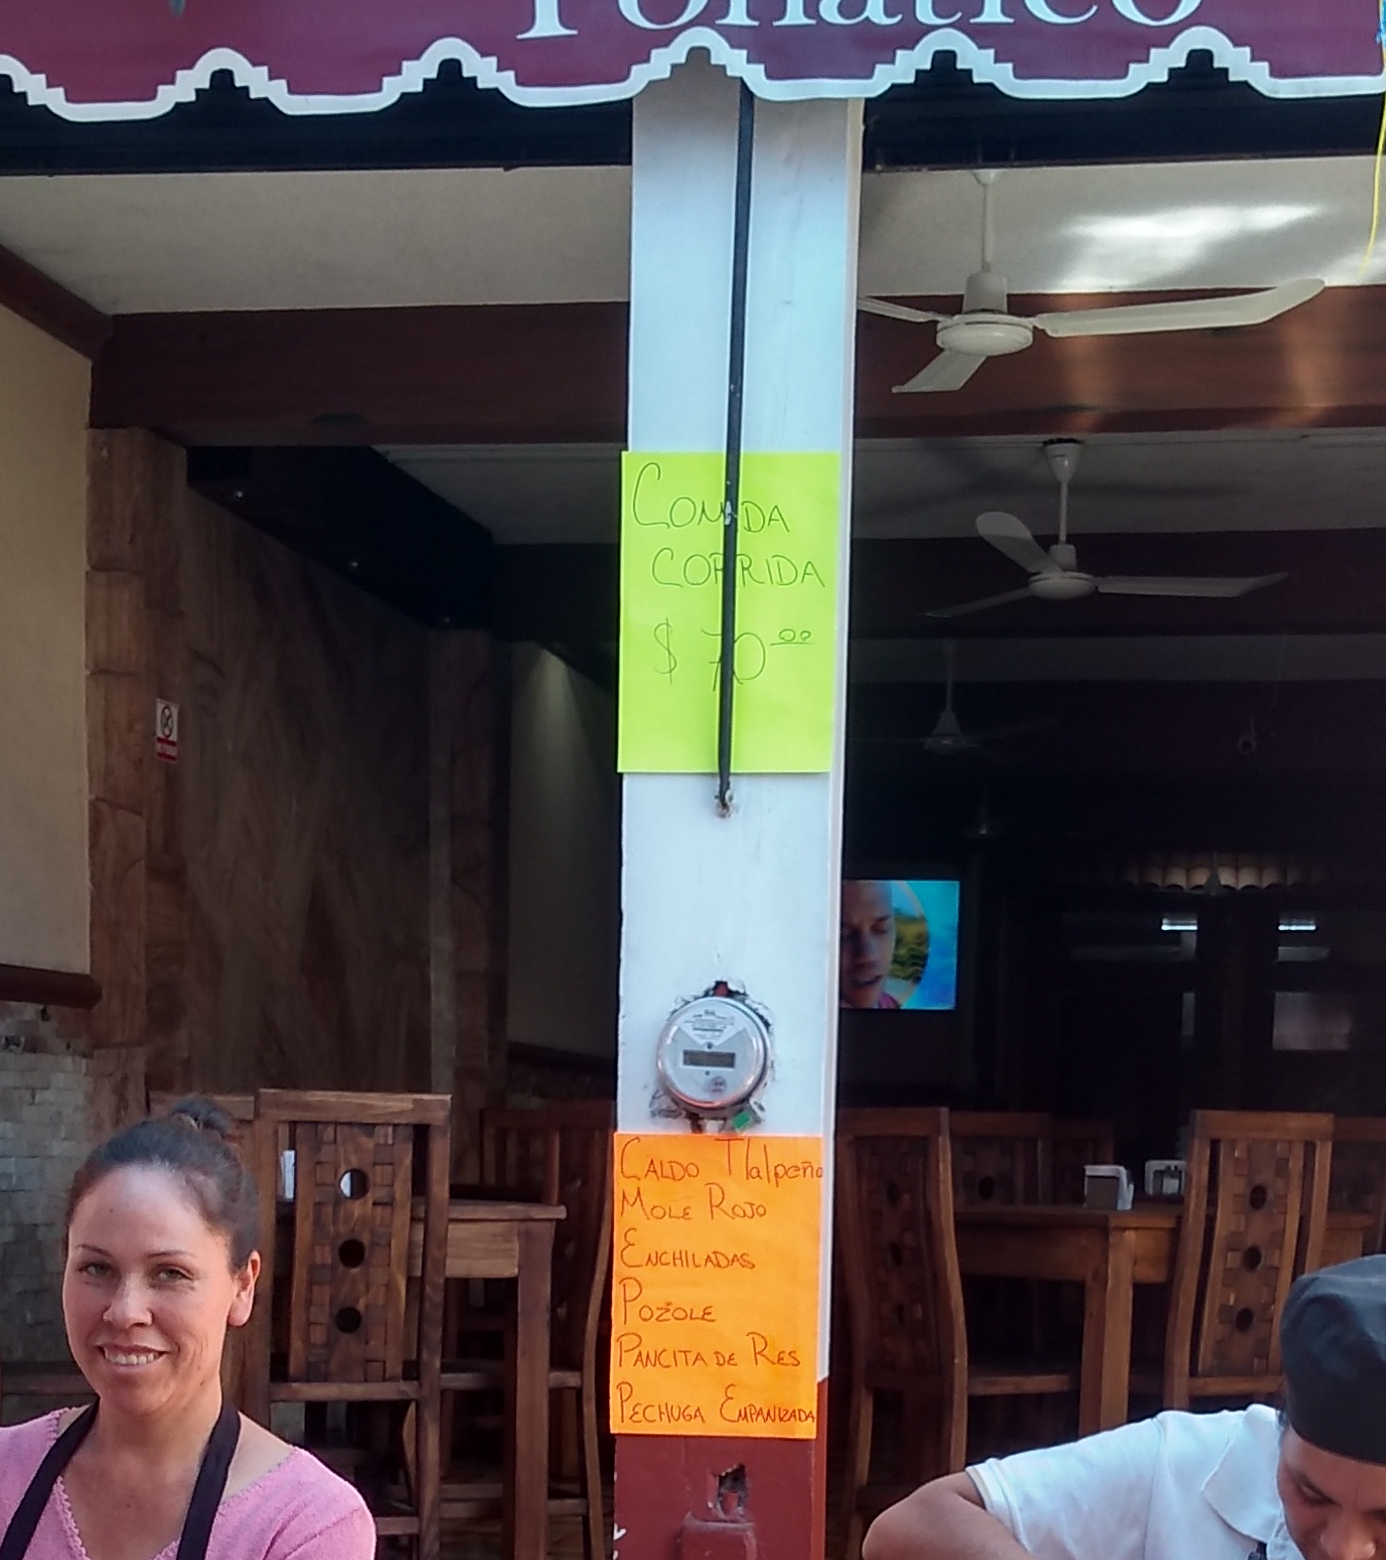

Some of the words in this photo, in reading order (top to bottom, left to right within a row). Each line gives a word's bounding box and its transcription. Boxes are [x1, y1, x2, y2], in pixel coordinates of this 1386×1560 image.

[633, 462, 789, 532] COMDA
[620, 1137, 700, 1181] CALDO
[620, 1186, 693, 1220] MOLE
[705, 1182, 767, 1220] ROJO
[620, 1228, 756, 1270] ENCHILADAS
[619, 1276, 717, 1325] POZOLE
[616, 1332, 707, 1368] PANCITA
[715, 1351, 738, 1367] DE
[746, 1331, 801, 1367] RES
[616, 1381, 705, 1424] PECHUGA
[720, 1383, 816, 1424] EMPANIZADA
